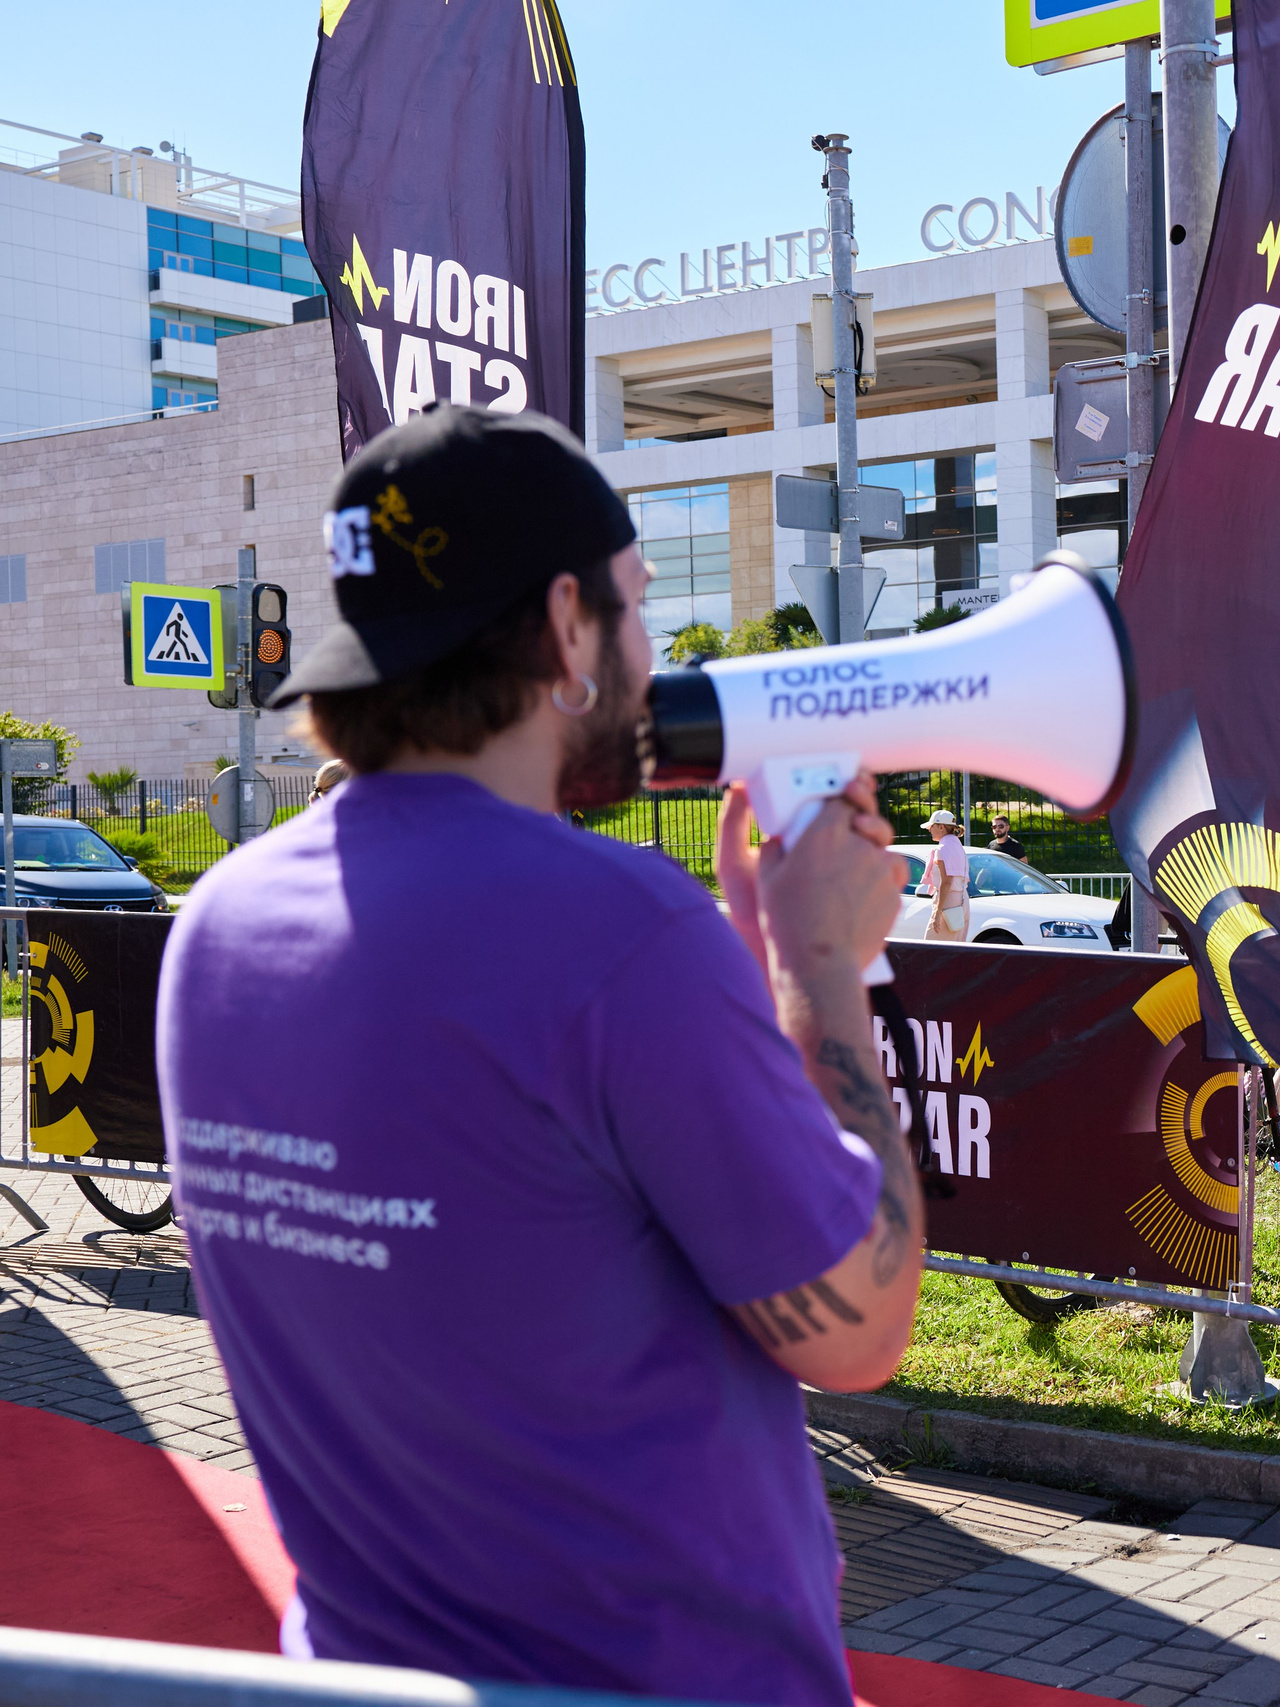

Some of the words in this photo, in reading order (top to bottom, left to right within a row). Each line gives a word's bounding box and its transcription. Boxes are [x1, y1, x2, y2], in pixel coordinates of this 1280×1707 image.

[921, 186, 1059, 252] CON
[586, 257, 665, 313] ЕСС
[680, 227, 832, 297] ЦЕНТР
[957, 594, 1000, 605] MANTE
[763, 659, 882, 688] ГОЛОС
[771, 674, 989, 719] ПОДДЕРЖКИ
[873, 1015, 952, 1083] RON
